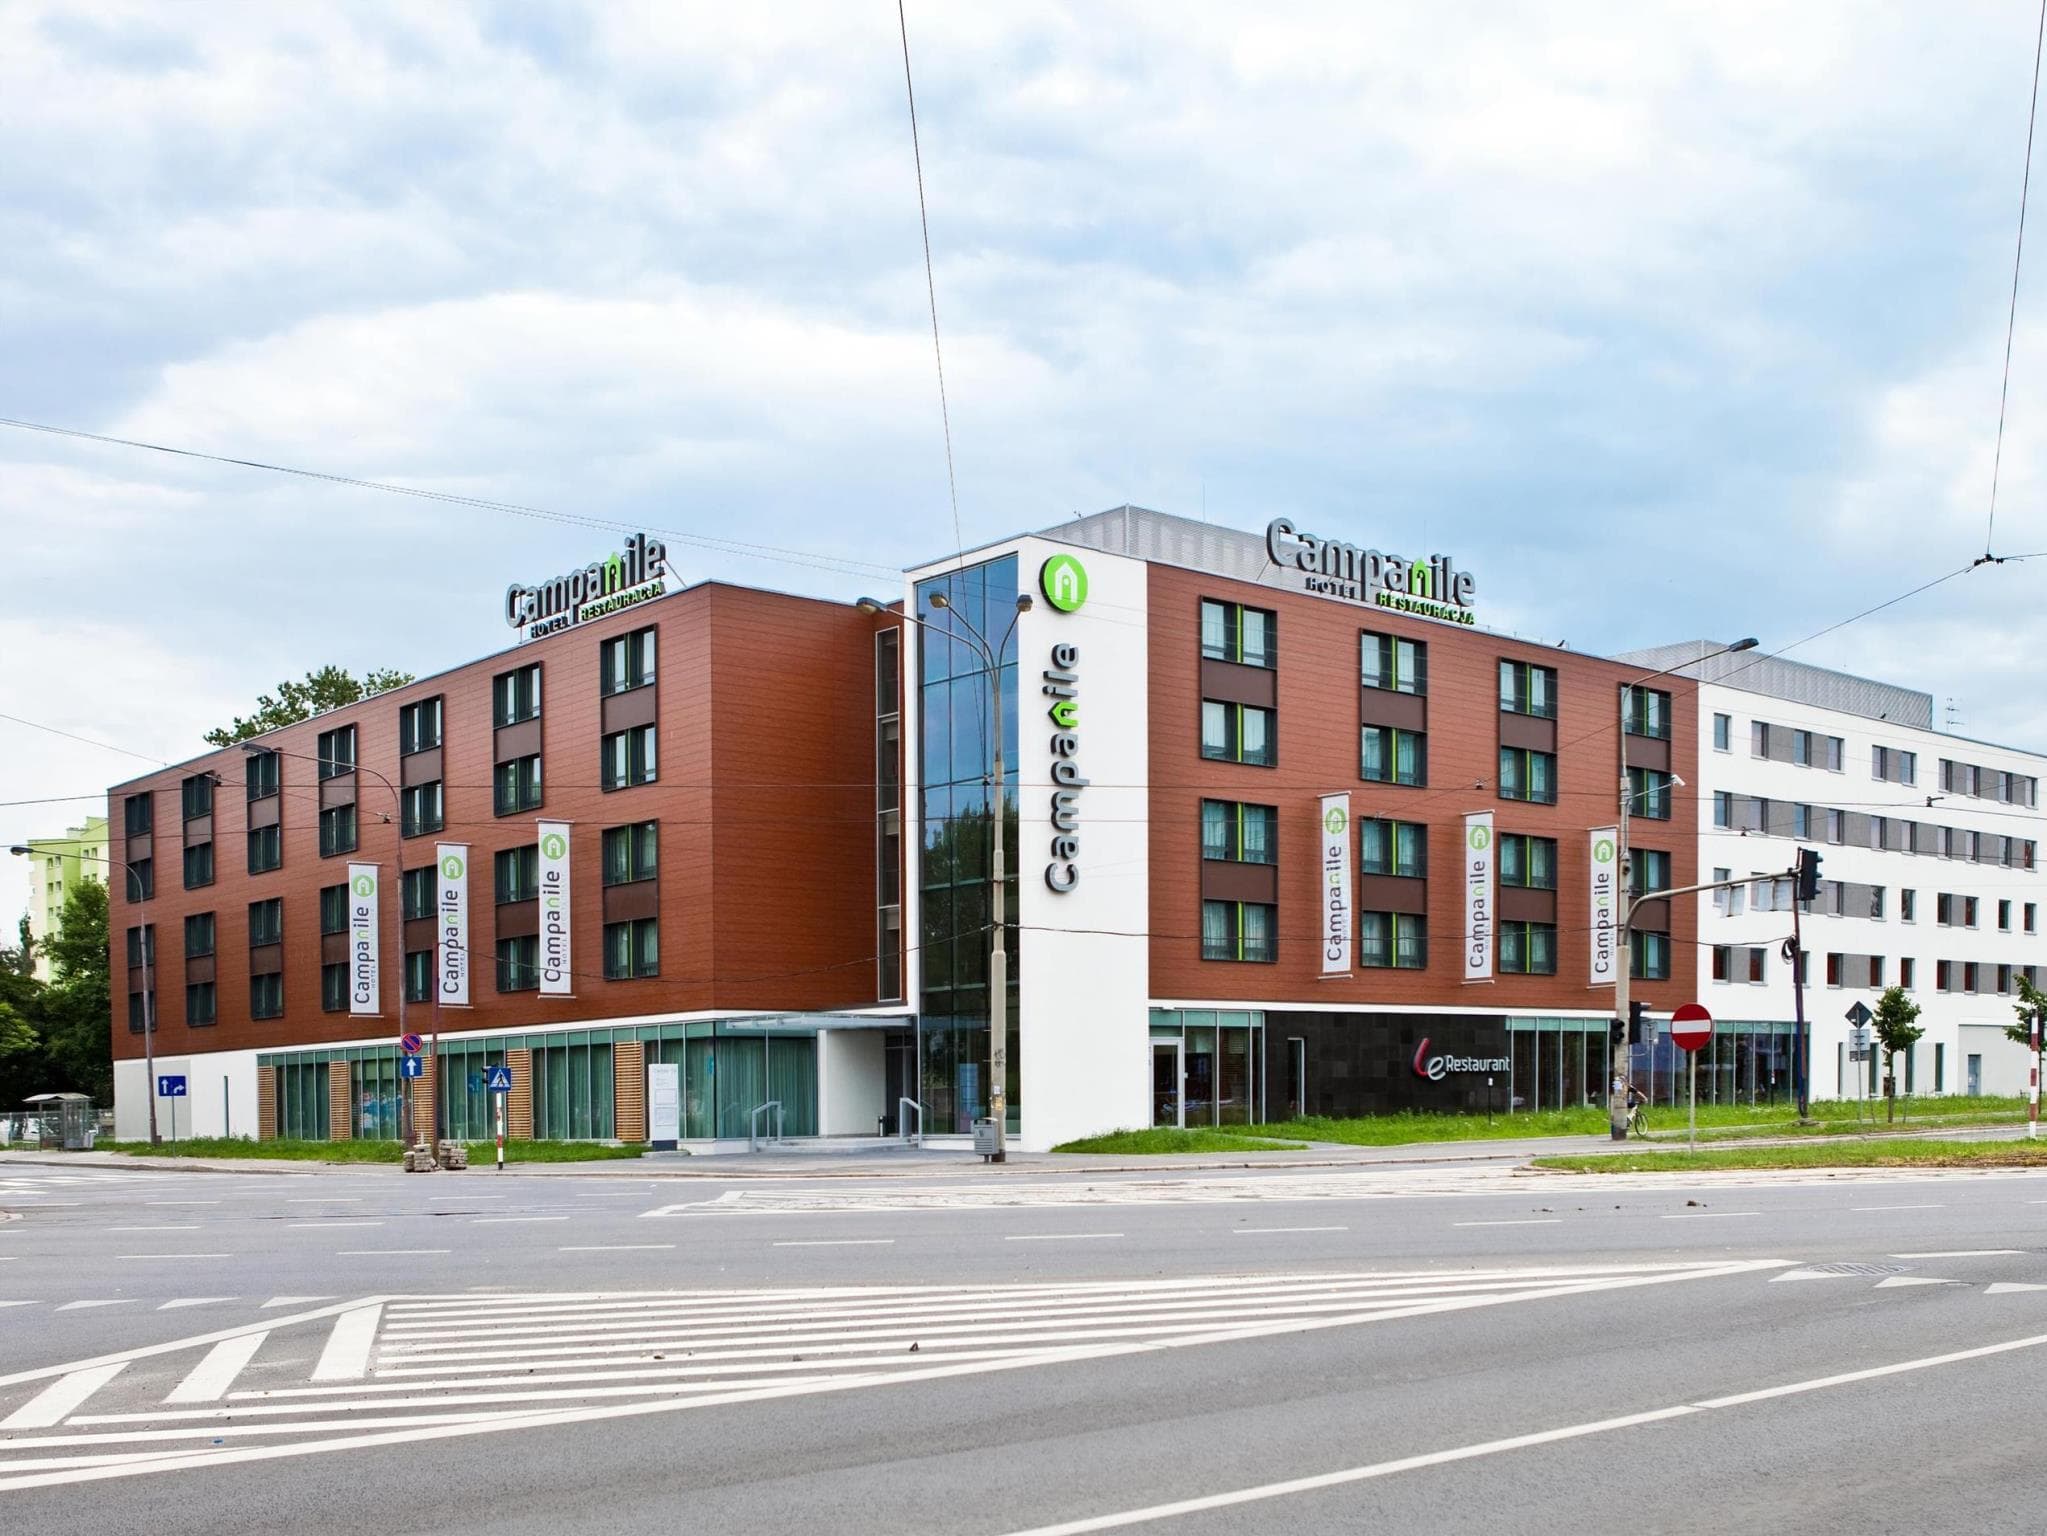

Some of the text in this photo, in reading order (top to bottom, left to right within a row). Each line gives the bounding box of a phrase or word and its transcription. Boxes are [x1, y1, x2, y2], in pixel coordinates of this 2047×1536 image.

[505, 533, 666, 629] Campanile
[530, 581, 666, 639] HOTEL RESTAURACJA
[1266, 517, 1476, 607] Campanile
[1376, 591, 1476, 625] RESTAURACJA
[1042, 643, 1090, 893] Campanile
[442, 890, 464, 994] Campanile
[543, 871, 566, 982] Campanile
[1326, 845, 1347, 961] Campanile
[1469, 860, 1490, 968] Campanile
[1594, 872, 1615, 974] Campanile
[353, 906, 375, 1004] Campanile
[1445, 1055, 1511, 1072] Restaurant
